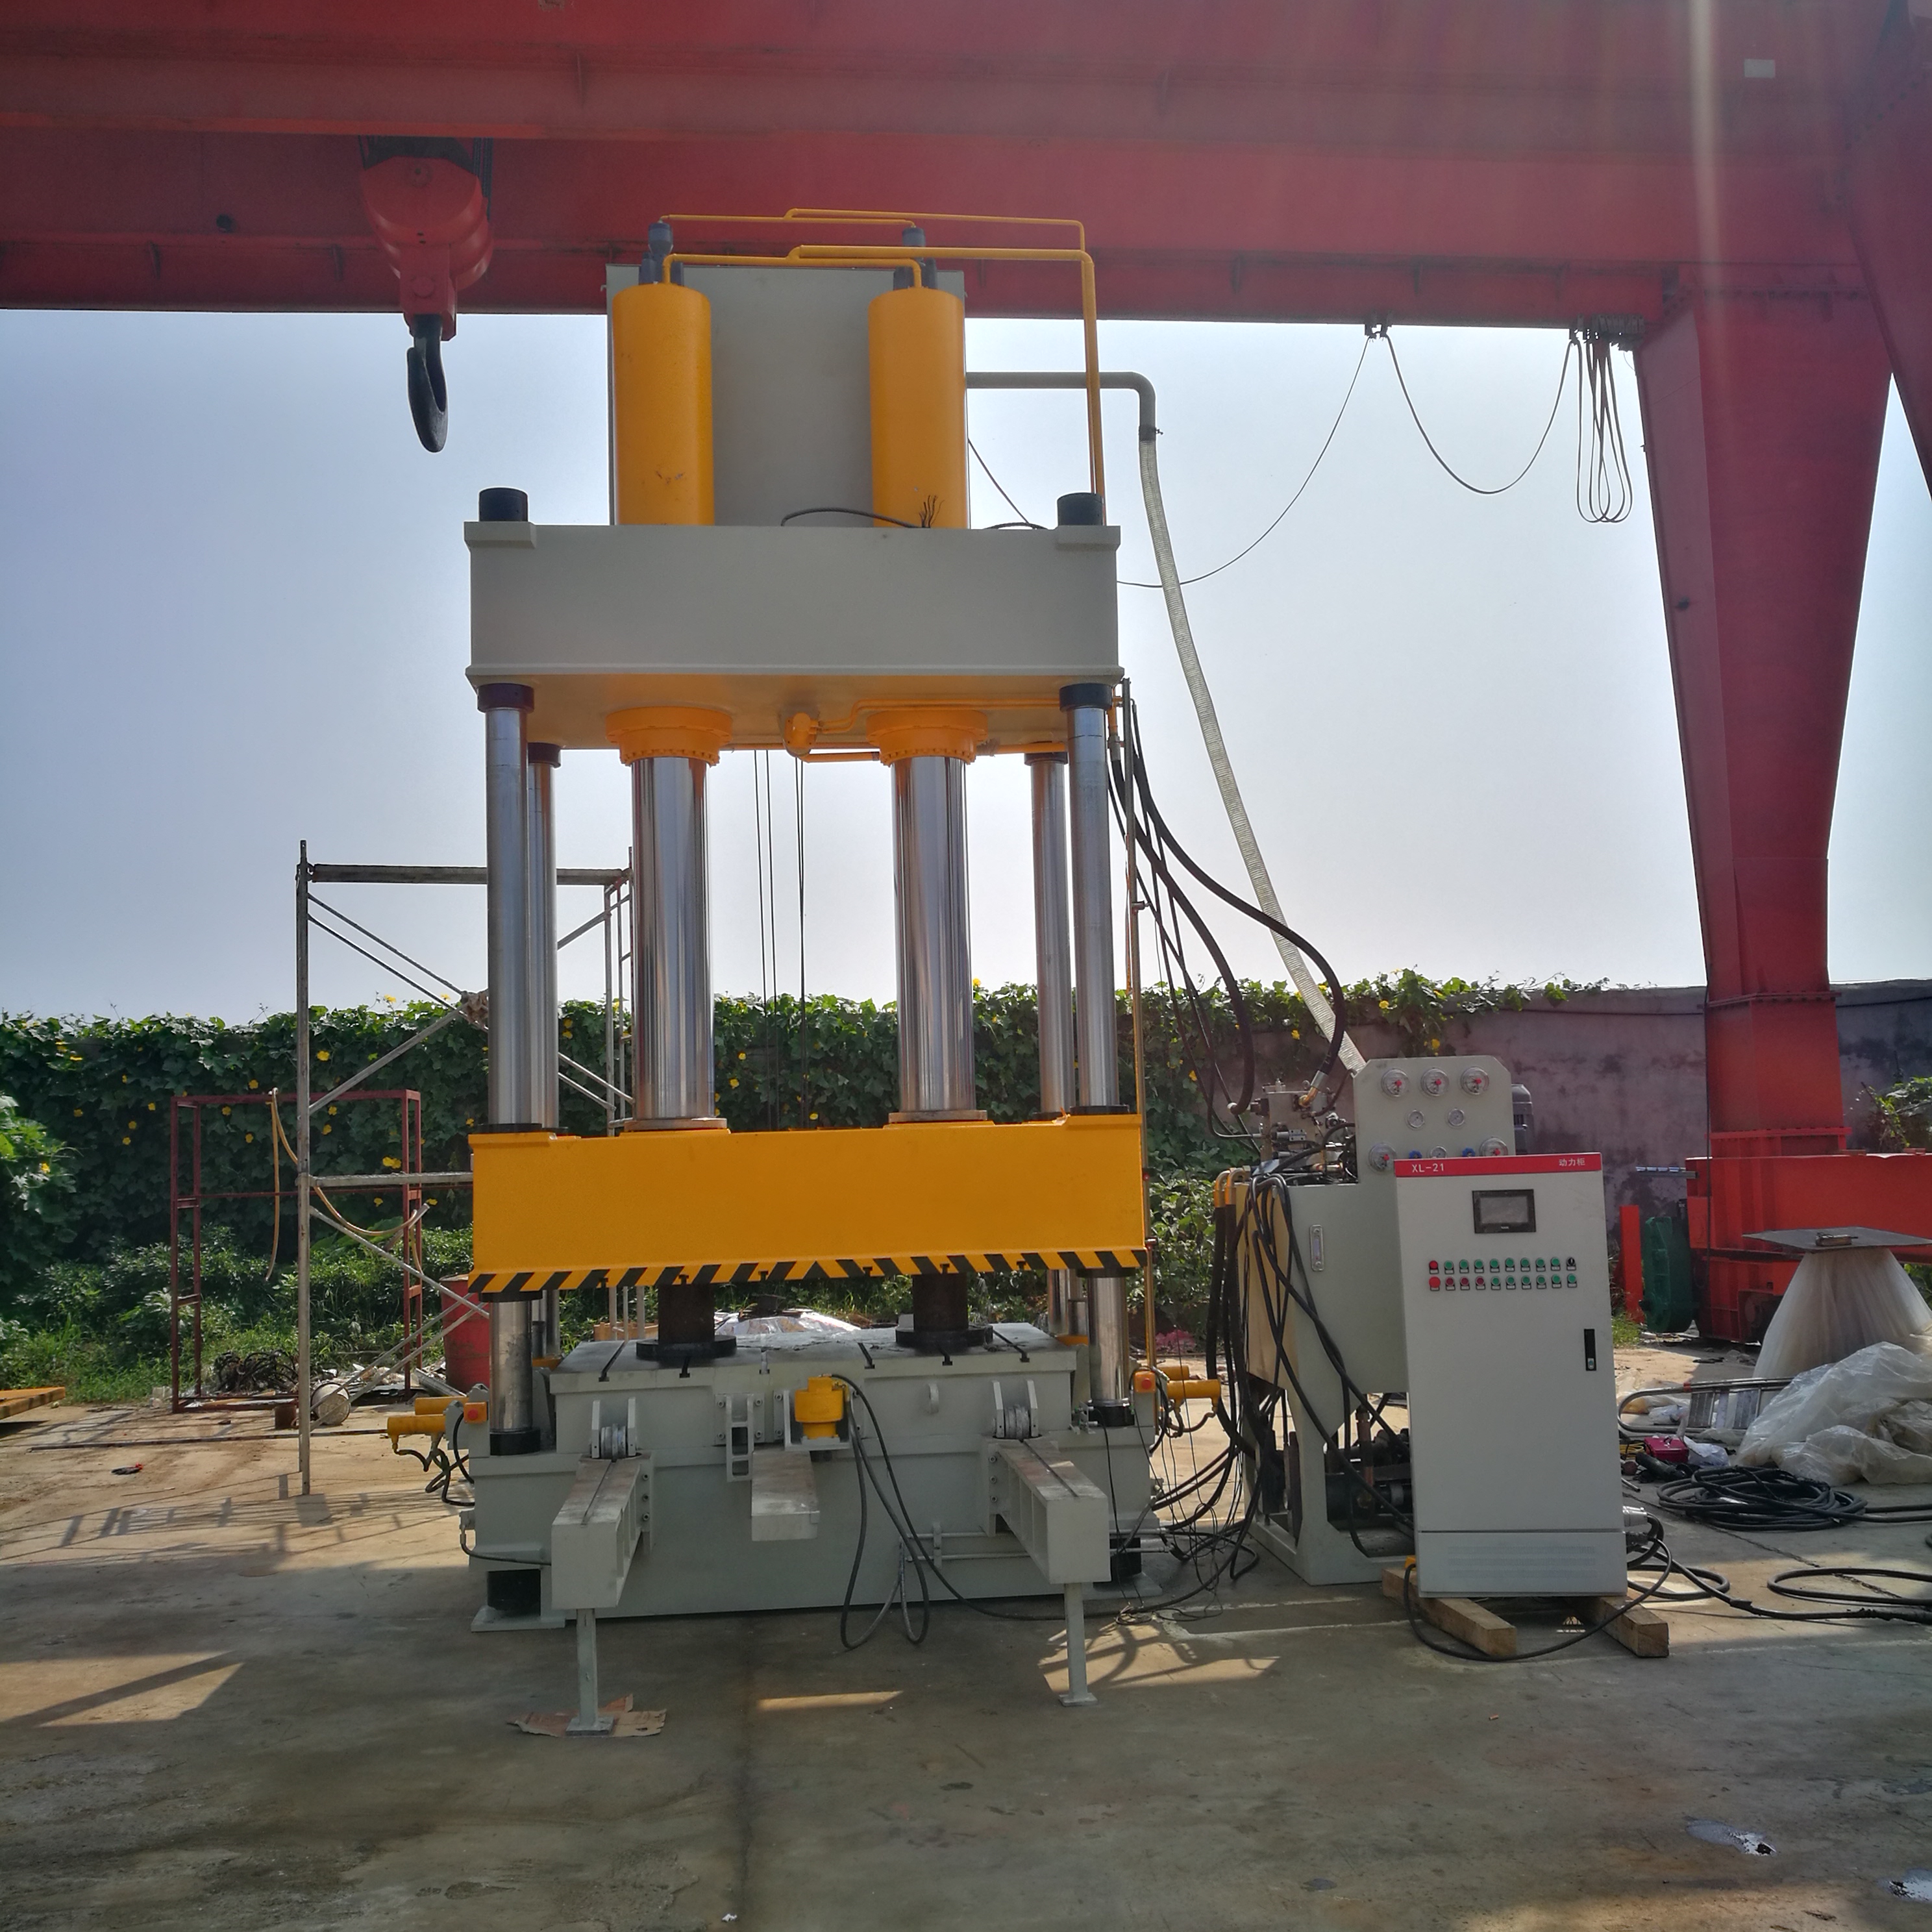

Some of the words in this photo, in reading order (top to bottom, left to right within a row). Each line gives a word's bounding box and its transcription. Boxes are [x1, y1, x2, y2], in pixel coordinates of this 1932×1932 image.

[1559, 1158, 1585, 1167] 动力柜
[1412, 1163, 1444, 1173] XL-21
